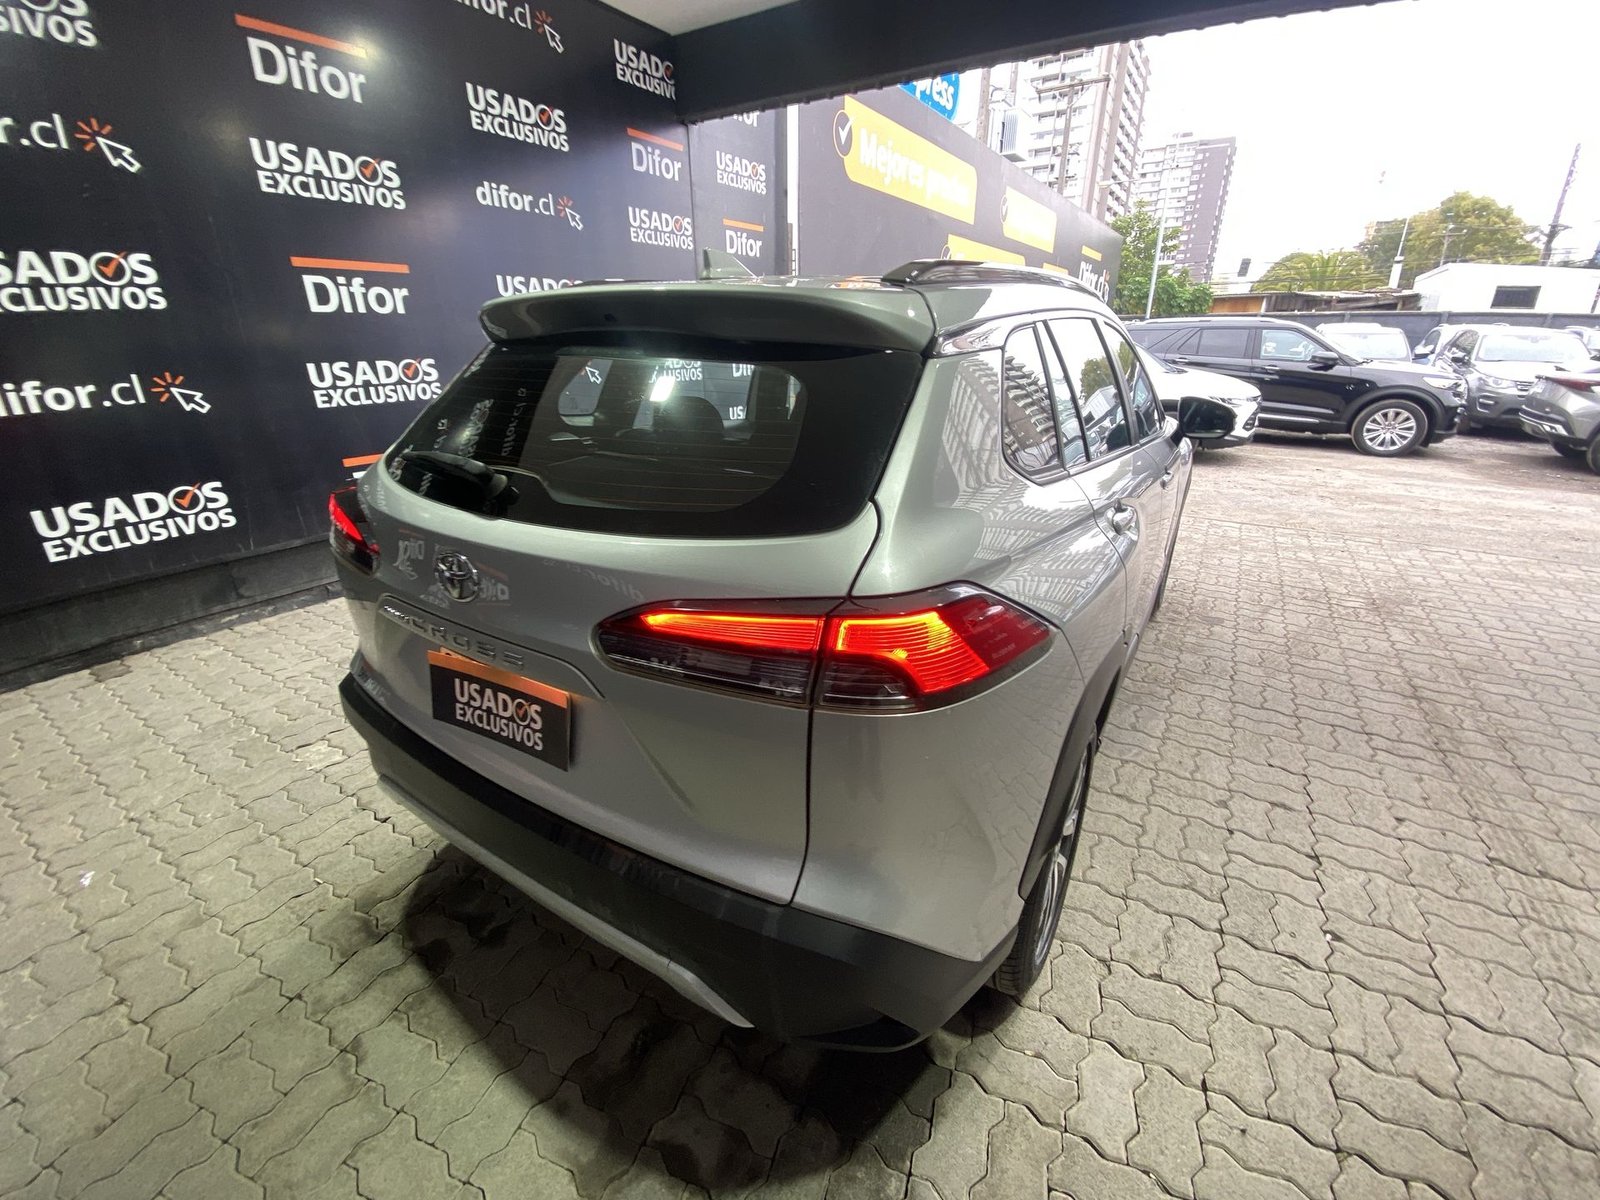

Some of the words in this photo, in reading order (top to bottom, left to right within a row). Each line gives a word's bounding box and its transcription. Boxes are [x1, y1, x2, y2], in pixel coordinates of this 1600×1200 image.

[247, 36, 366, 103] Difor
[613, 38, 675, 85] USADO
[615, 62, 676, 101] EXCLUSIV
[465, 81, 567, 133] USADOS
[470, 110, 570, 152] EXCLUSIVOS
[249, 137, 401, 188] USADOS
[631, 141, 682, 181] Difor
[716, 150, 766, 182] USADOS
[256, 170, 407, 210] EXCLUSIVOS
[476, 181, 555, 216] difor.cl
[716, 169, 767, 195] EXCLUSIVOS
[628, 206, 693, 236] USADOS
[630, 227, 694, 250] EXCLUSIVOS
[726, 229, 762, 258] Difor
[0, 286, 168, 312] CLUSIVOS
[302, 274, 410, 314] Difor
[305, 358, 440, 388] USADOS
[313, 382, 442, 409] EXCLUSIVOS
[729, 406, 748, 420] US
[29, 481, 229, 538] USADOS
[42, 508, 237, 562] EXCLUSIVOS
[454, 677, 543, 730] USADOS
[455, 702, 544, 751] EXCLUSIVOS
